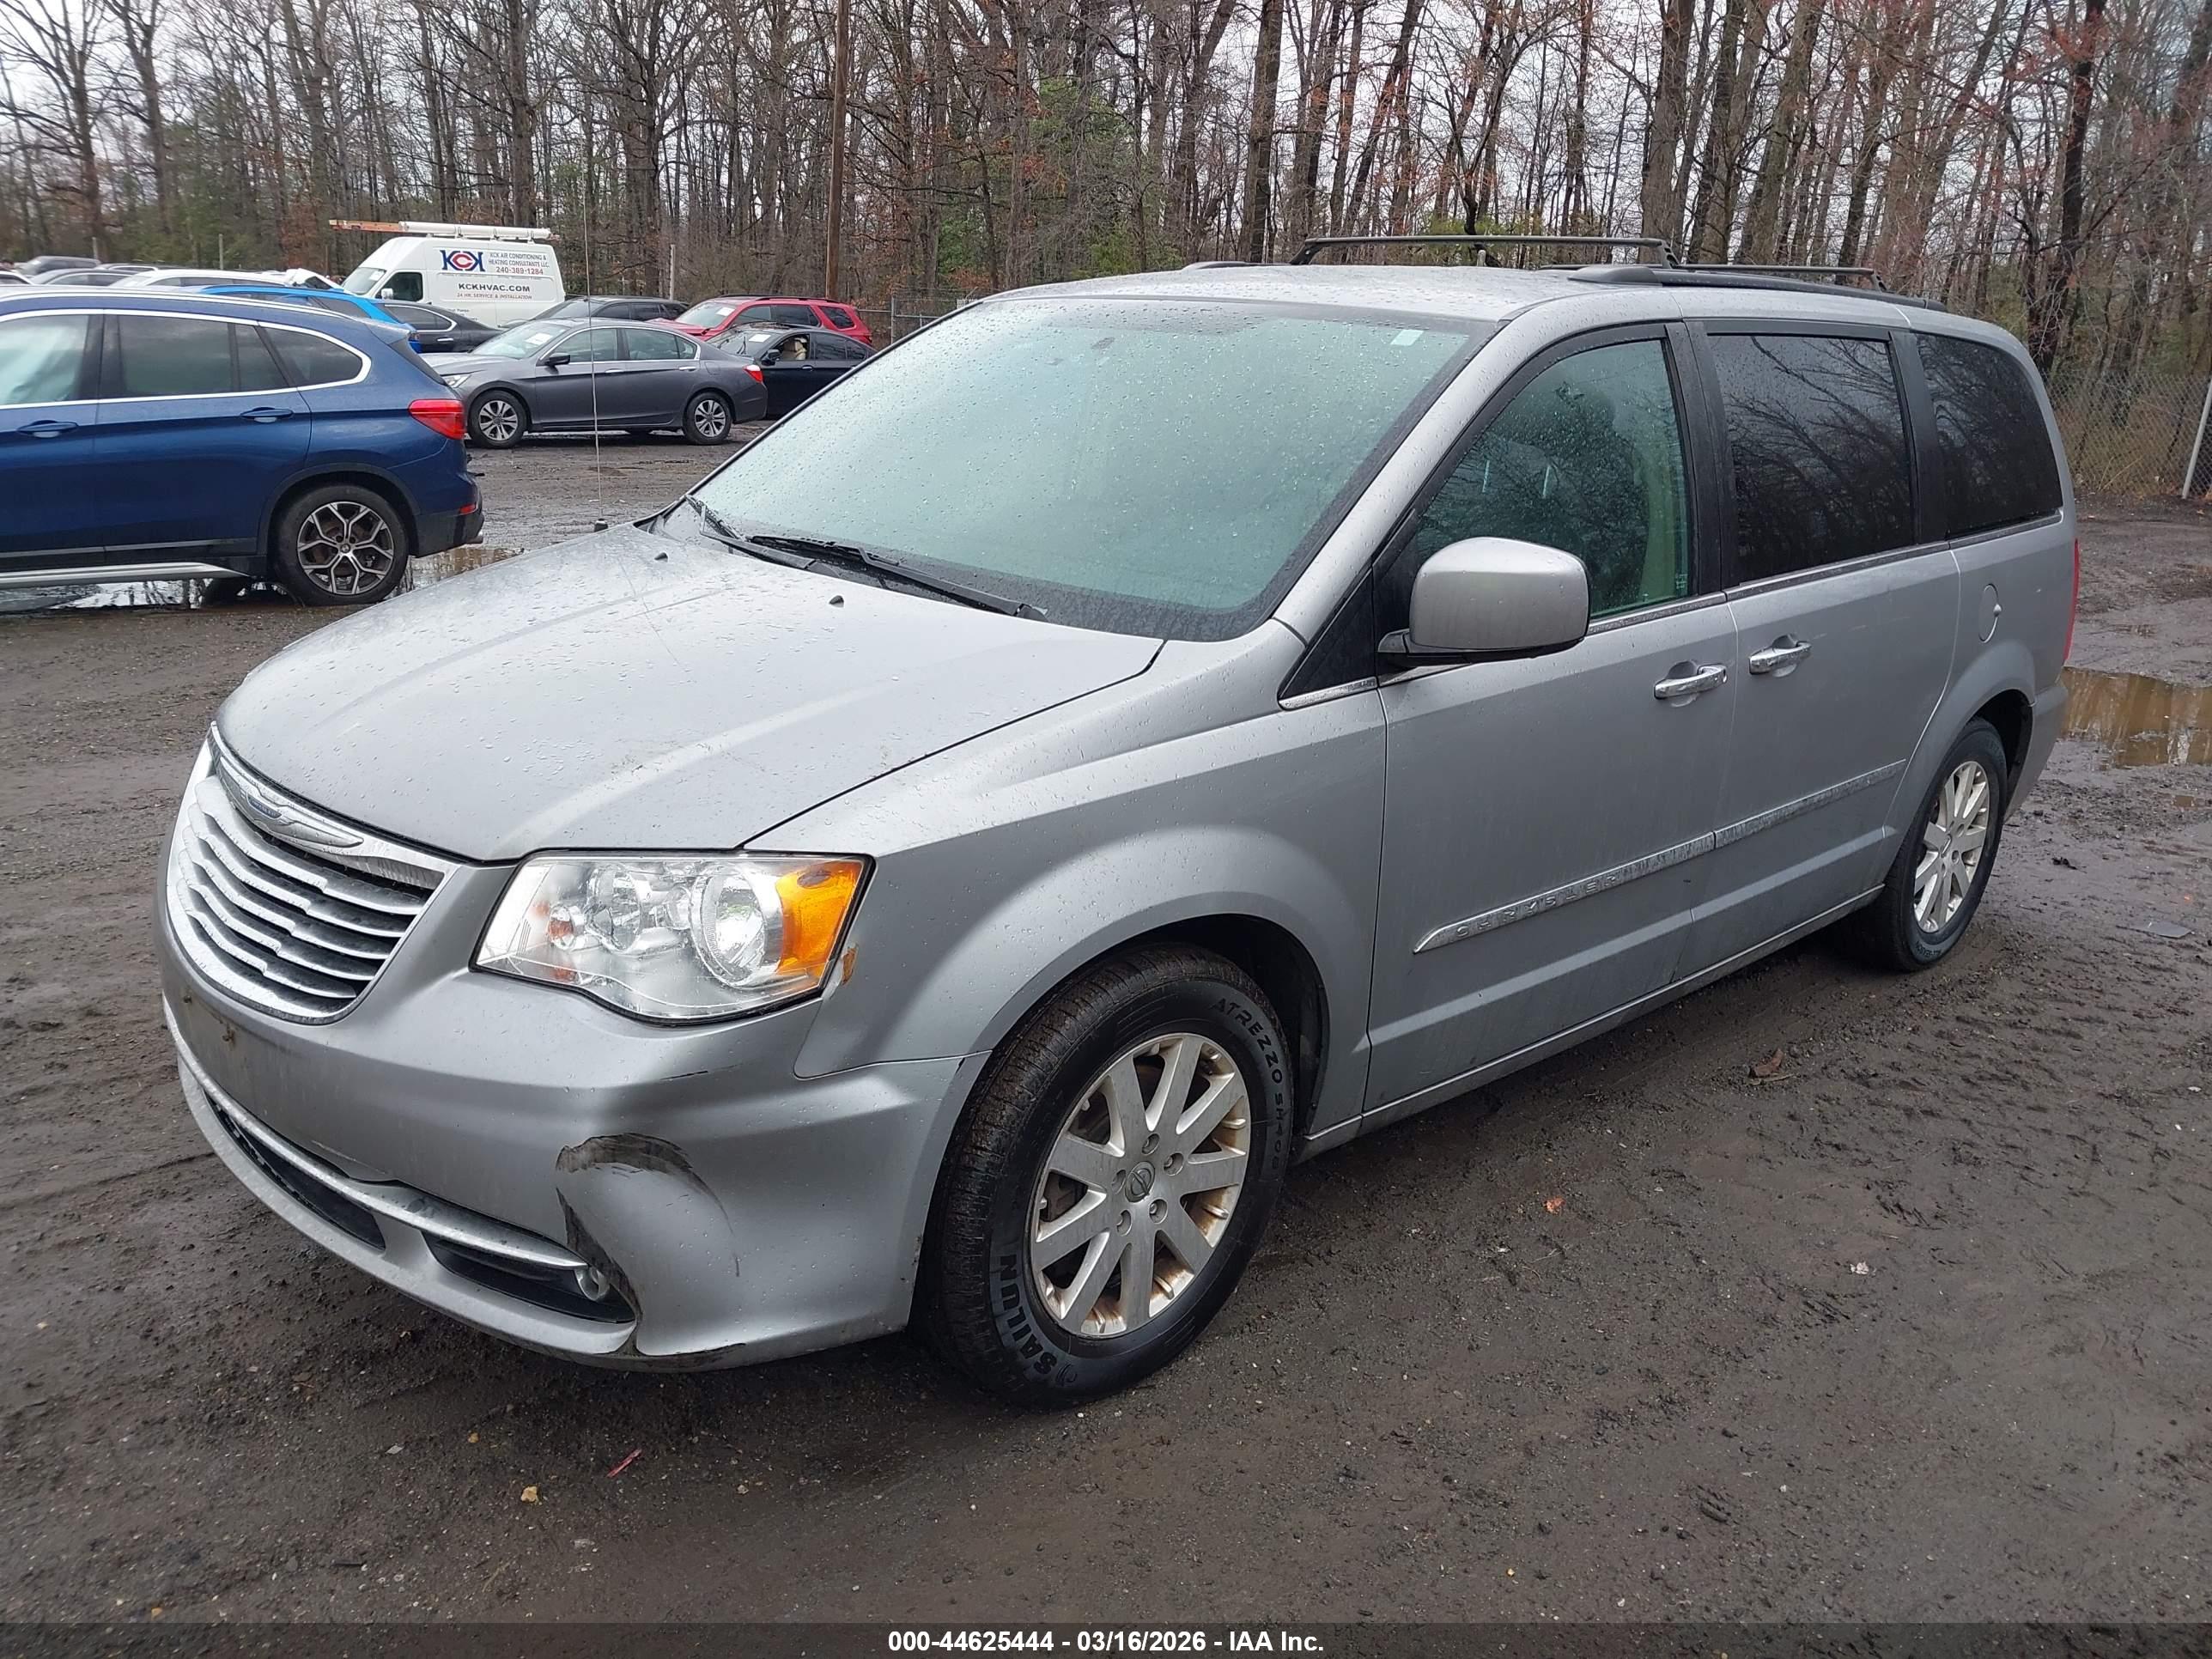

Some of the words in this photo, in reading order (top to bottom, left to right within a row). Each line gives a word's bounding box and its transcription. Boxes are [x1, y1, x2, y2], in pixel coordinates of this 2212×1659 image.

[459, 283, 531, 292] KCKHVAC.COM
[1456, 874, 1616, 937] CHRYSLER
[1212, 998, 1283, 1084] ATREZZO
[1000, 1255, 1057, 1375] SAILUN
